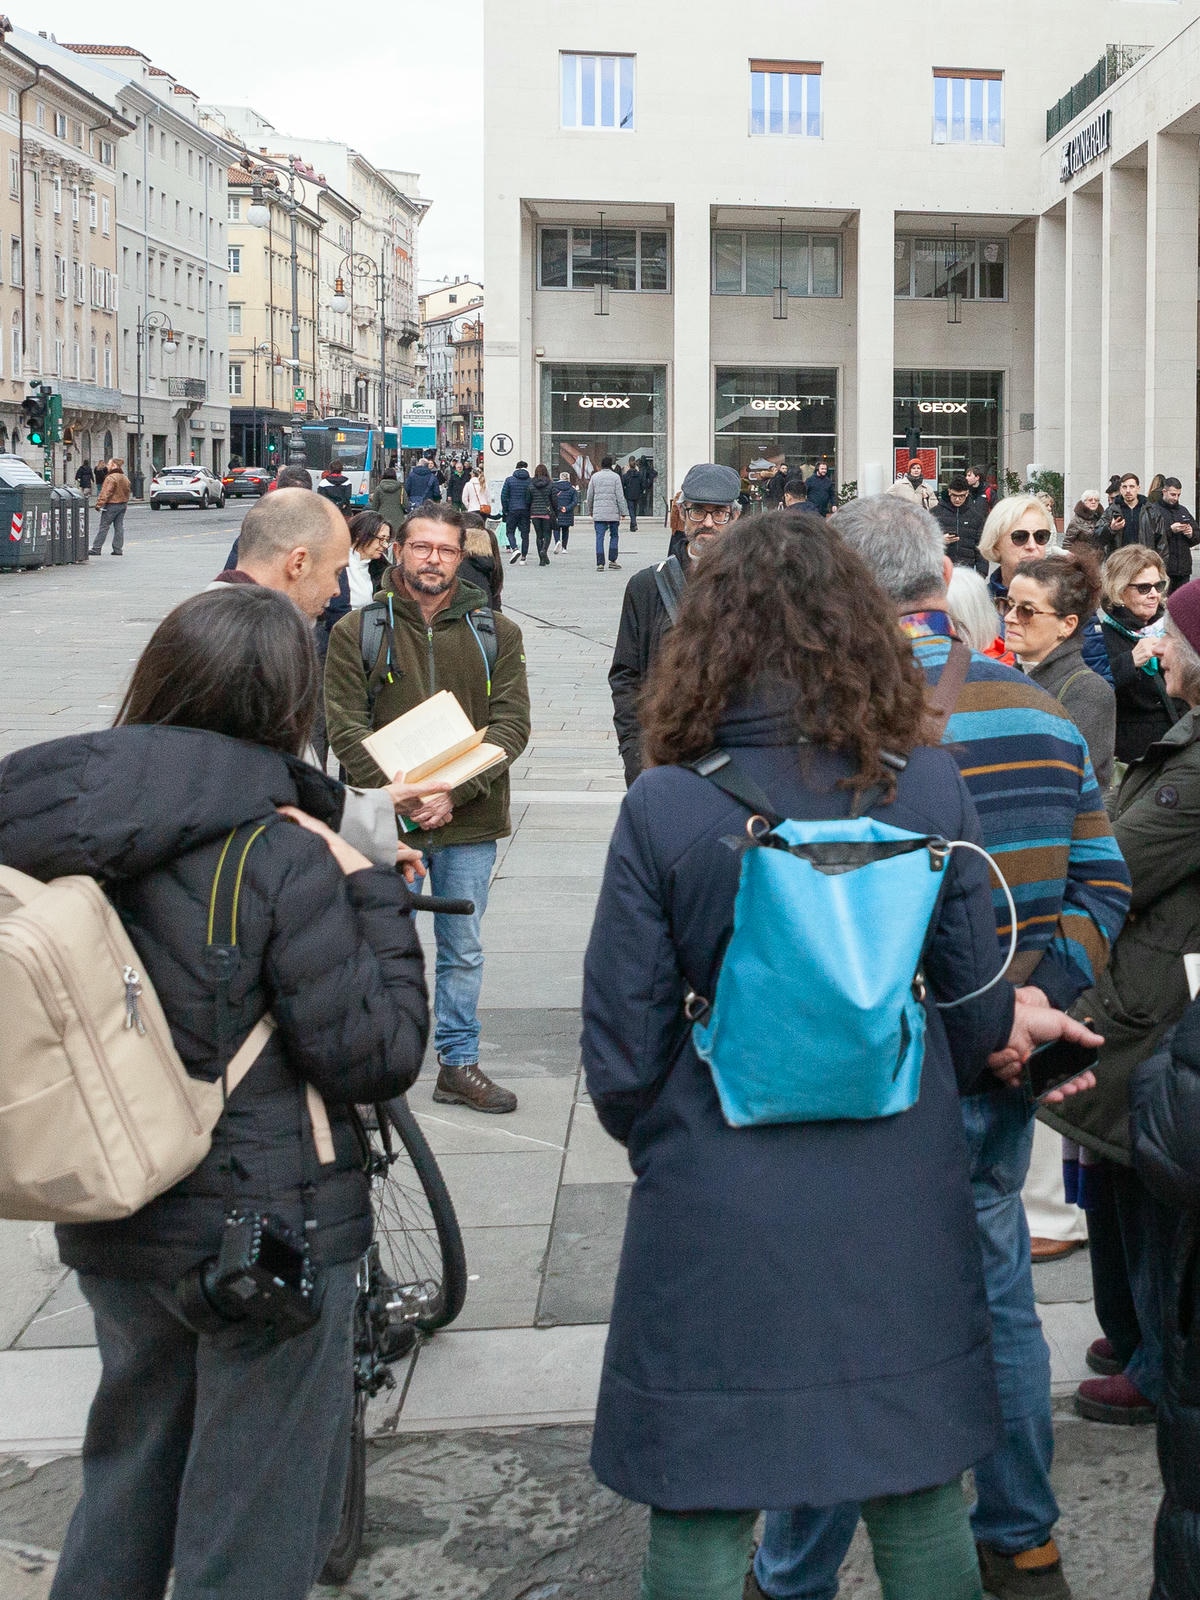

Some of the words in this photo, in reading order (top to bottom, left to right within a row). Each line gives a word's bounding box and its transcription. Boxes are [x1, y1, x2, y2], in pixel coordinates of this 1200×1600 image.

[1069, 109, 1112, 174] GENERALI
[578, 397, 631, 408] GEOX
[751, 399, 801, 411] GEOX
[918, 402, 968, 413] GEOX
